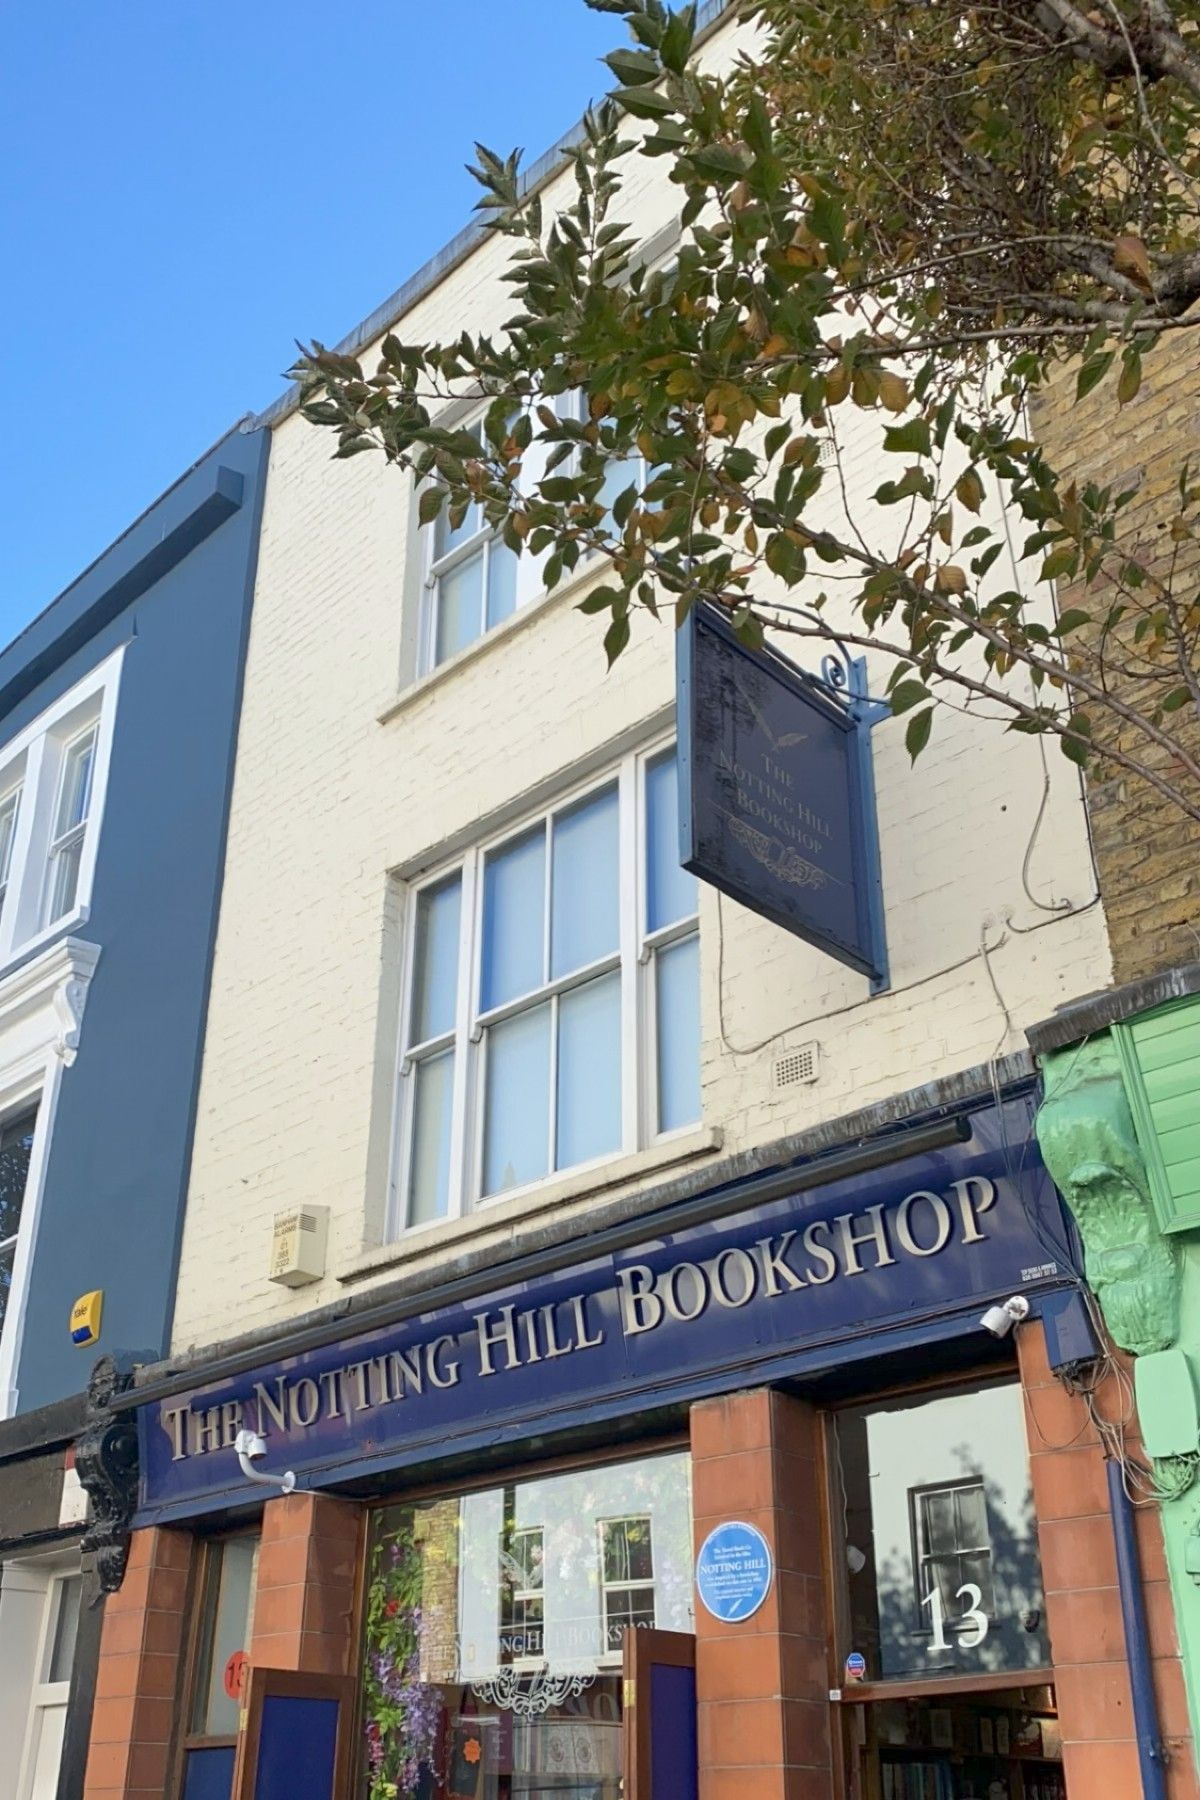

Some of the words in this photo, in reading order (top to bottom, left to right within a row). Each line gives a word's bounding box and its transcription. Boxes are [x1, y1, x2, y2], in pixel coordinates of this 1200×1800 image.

[720, 749, 794, 813] NOTTING
[797, 801, 833, 841] HILL
[760, 752, 794, 790] THE
[737, 787, 823, 854] BOOKSHOP
[165, 1400, 243, 1461] THE
[253, 1334, 460, 1439] NOTTING
[472, 1294, 604, 1377] HILL
[616, 1175, 996, 1337] BOOKSHOP
[700, 1560, 742, 1576] NOTTING
[744, 1557, 767, 1570] HILL
[920, 1582, 989, 1651] 13
